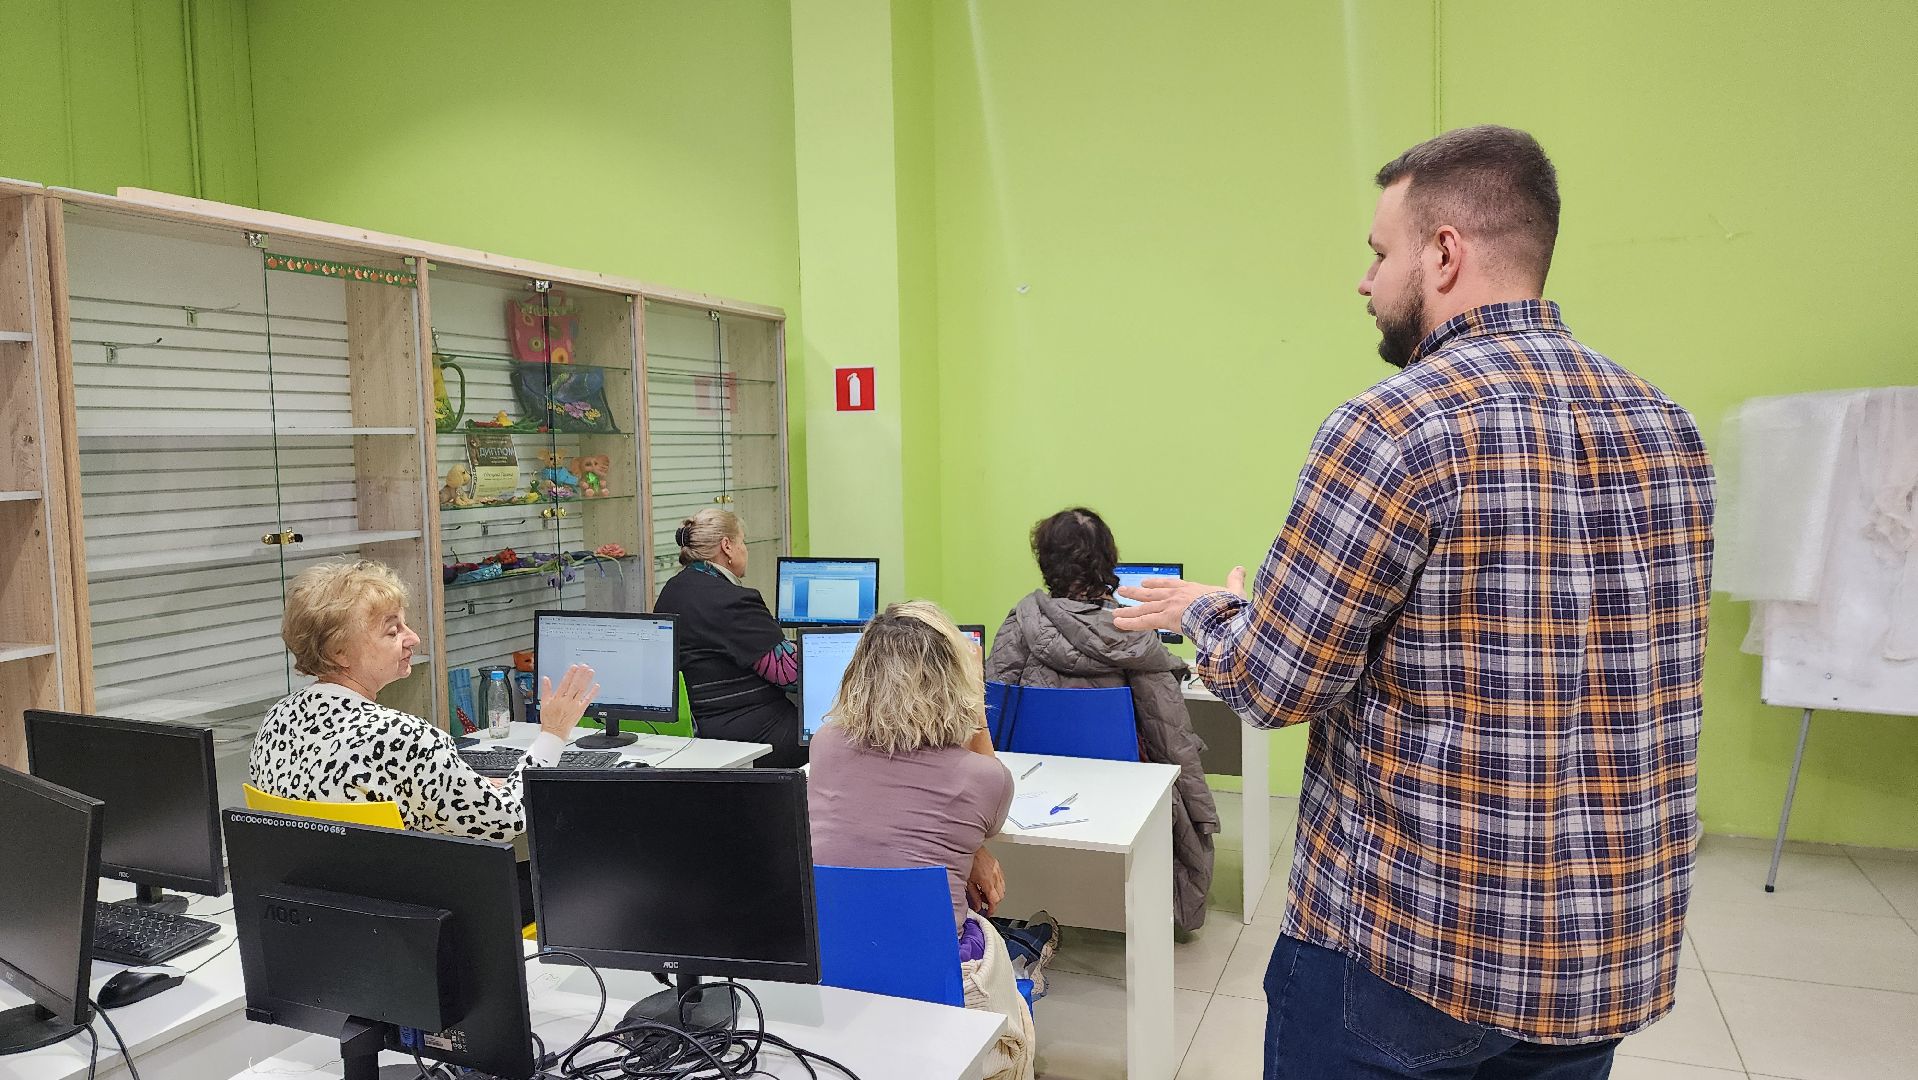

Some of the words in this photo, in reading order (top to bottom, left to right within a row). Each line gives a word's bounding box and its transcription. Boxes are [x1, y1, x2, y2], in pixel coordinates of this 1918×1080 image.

[480, 447, 515, 457] ДИПЛОМ
[264, 904, 300, 924] AOC
[662, 961, 680, 969] AOC
